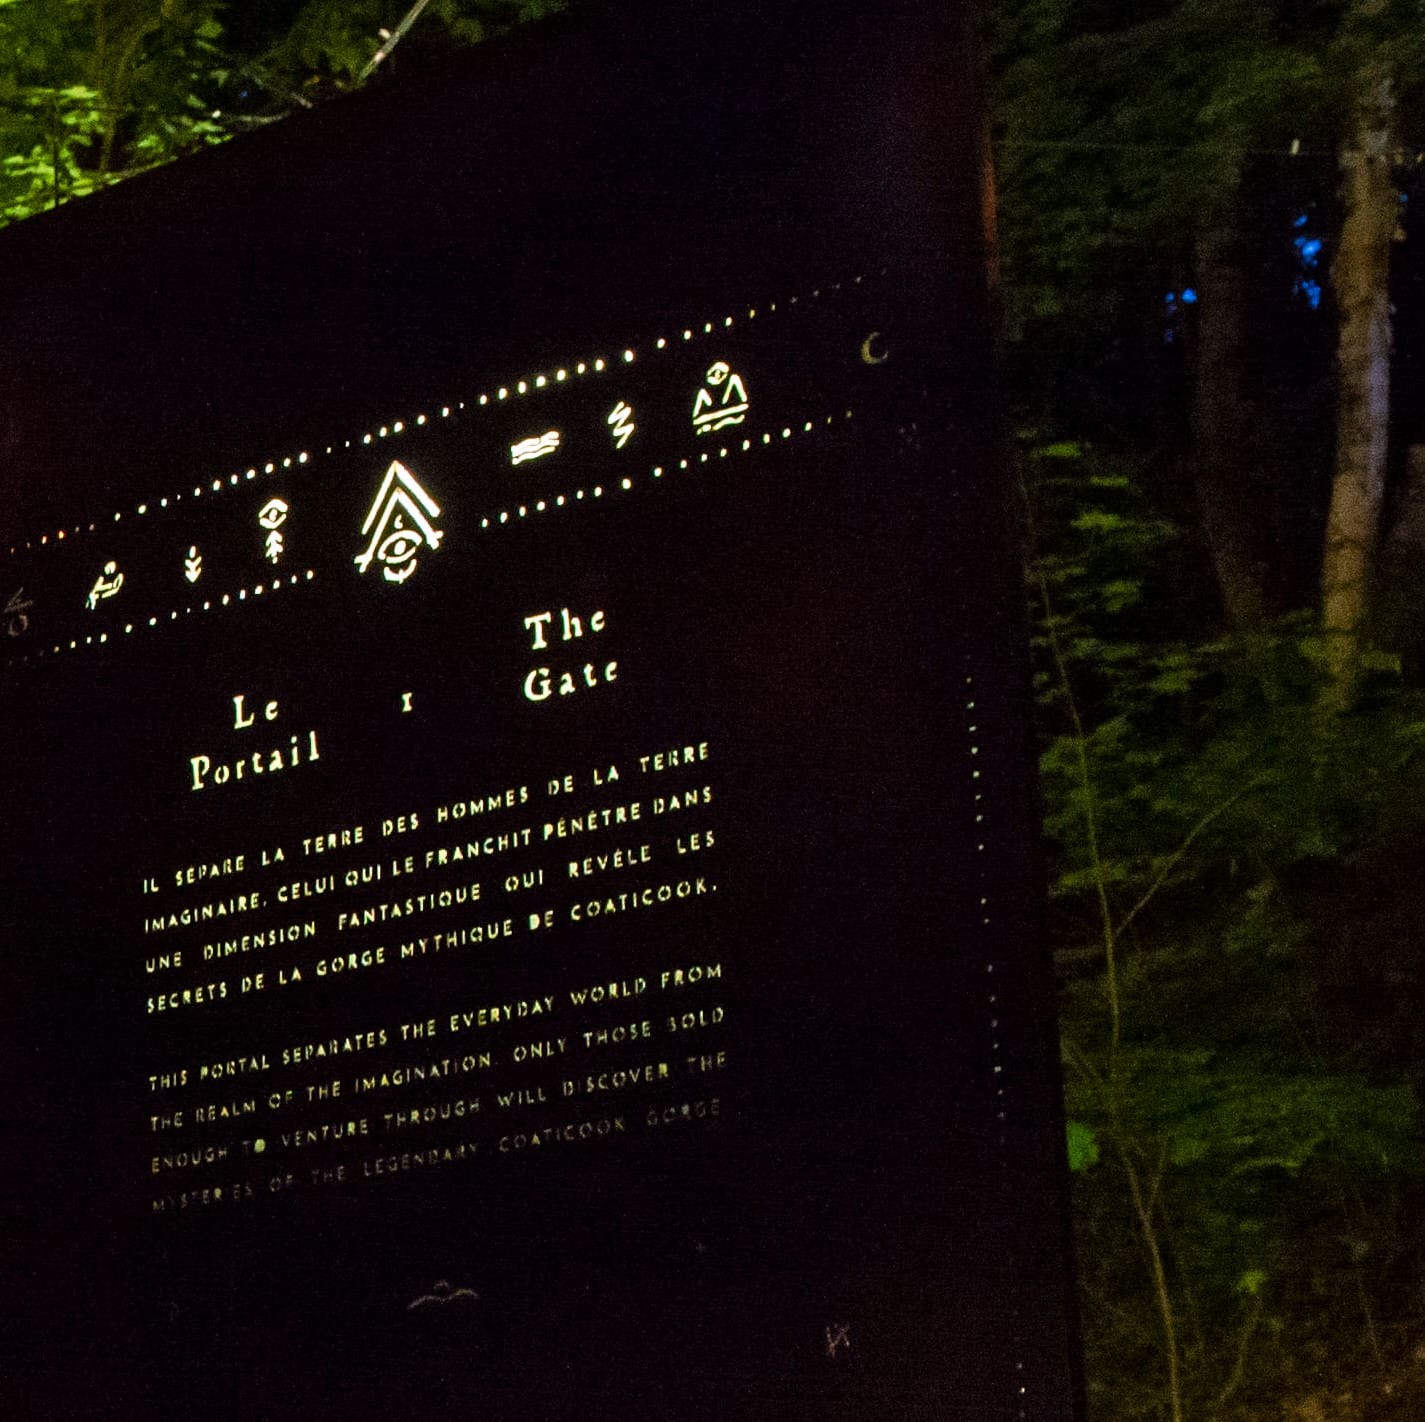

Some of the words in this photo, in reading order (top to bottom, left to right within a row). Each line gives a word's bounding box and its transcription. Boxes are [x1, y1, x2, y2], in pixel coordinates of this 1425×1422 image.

[524, 608, 605, 649] The
[524, 662, 617, 701] Gate
[191, 727, 319, 790] Portail
[233, 695, 278, 729] Le
[142, 876, 161, 895] IL
[260, 846, 286, 868] LA
[301, 824, 365, 857] TERRE
[381, 811, 420, 838] DES
[436, 784, 530, 824] HOMMES
[546, 773, 575, 796] DE
[592, 764, 620, 787] LA
[638, 740, 709, 774] TERRE
[276, 874, 336, 904] CELUI
[343, 862, 383, 888] QUI
[391, 855, 415, 878] LE
[424, 827, 532, 870] FRANCHIT
[652, 784, 713, 816] DANS
[144, 950, 183, 974] UNE
[202, 919, 317, 961] DIMENSION
[337, 882, 482, 932] FANTASTIQUE
[503, 867, 545, 894] QUI
[675, 829, 716, 856] LES
[146, 980, 228, 1015] SECRETS
[240, 971, 266, 994] DE
[277, 966, 303, 986] LA
[315, 945, 386, 978] GORGE
[399, 917, 514, 960] MYTHIQUE
[527, 908, 555, 932] DE
[569, 876, 718, 922] COATICOOK.
[147, 1068, 189, 1092] THIS
[199, 1053, 271, 1081] PORTAL
[281, 1028, 389, 1066] SEPARATES
[399, 1017, 437, 1042] THE
[449, 995, 555, 1033] EVERYDAY
[568, 976, 648, 1007] WORLD
[660, 962, 723, 990] FROM
[149, 1110, 184, 1133] THE
[194, 1099, 257, 1123] REALM
[267, 1088, 294, 1110] OF
[305, 1079, 342, 1103] THE
[512, 1037, 567, 1064] ONLY
[581, 1019, 652, 1049] THOSE
[150, 1146, 229, 1175] ENOUGH
[280, 1117, 370, 1148] VENTURE
[382, 1097, 481, 1128] THROUGH
[496, 1086, 548, 1108] WILL
[561, 1061, 670, 1098] DISCOVER
[686, 1050, 727, 1073] THE
